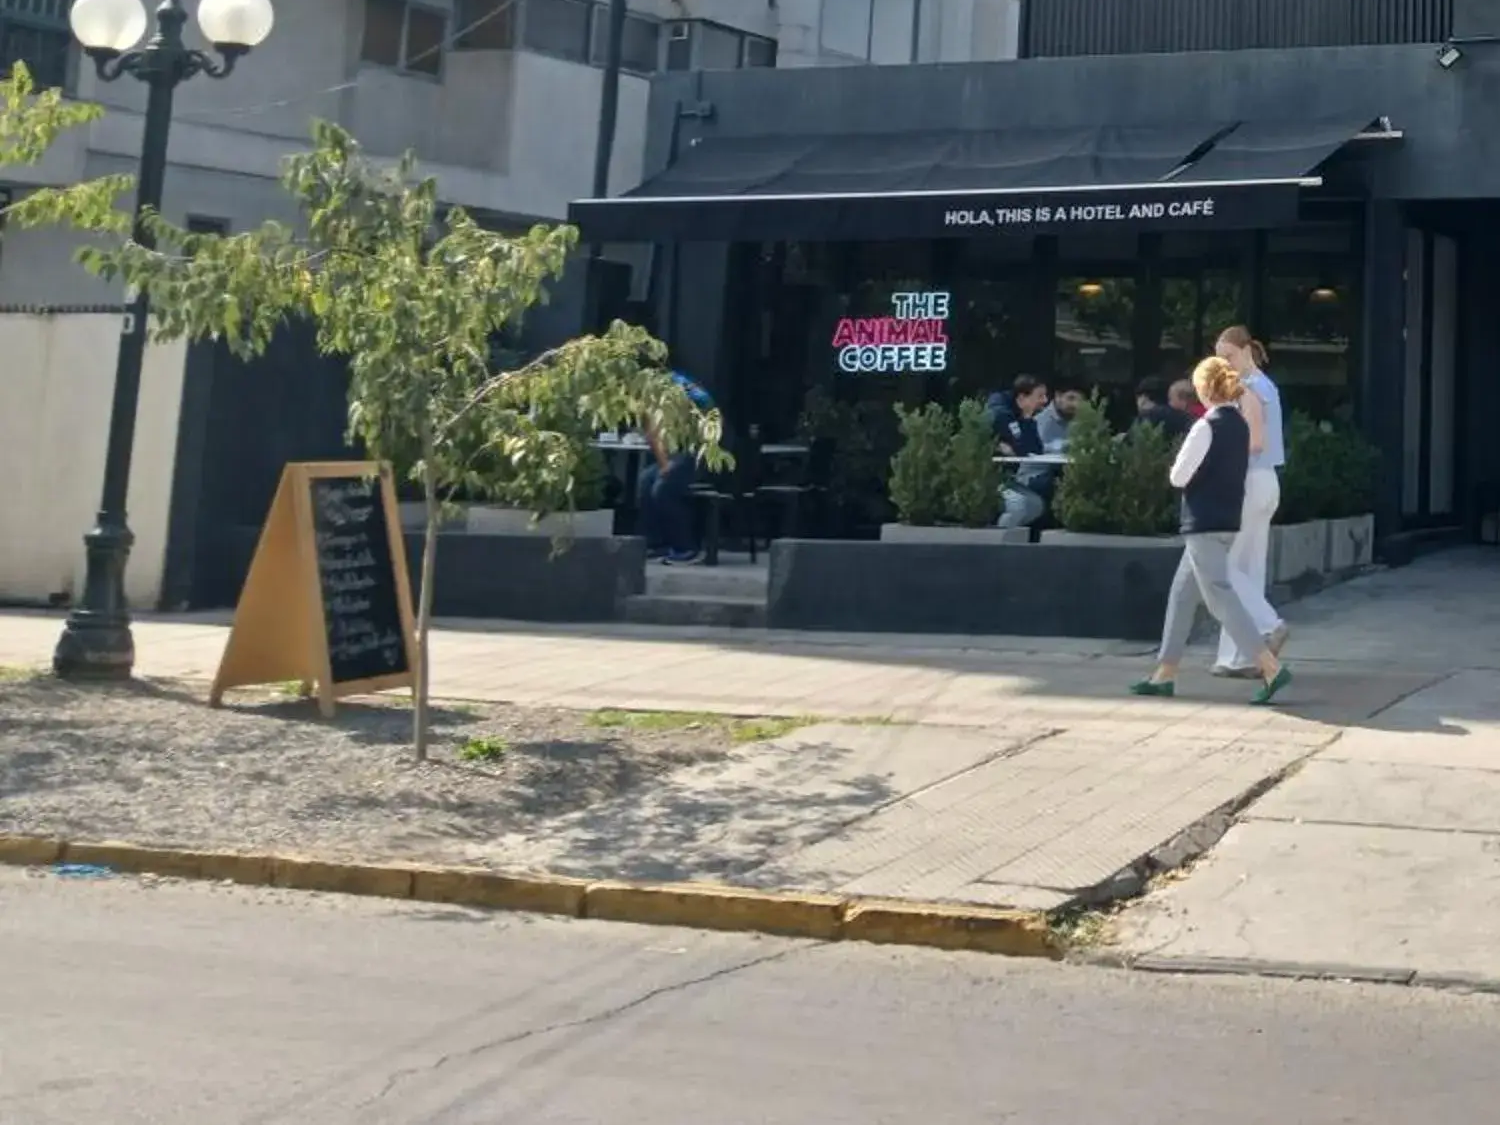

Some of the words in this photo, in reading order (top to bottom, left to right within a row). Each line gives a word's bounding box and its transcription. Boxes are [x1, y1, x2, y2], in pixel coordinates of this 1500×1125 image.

[945, 209, 994, 226] HOLA,
[996, 207, 1032, 224] THIS
[1036, 206, 1051, 223] IS
[1054, 205, 1067, 221] A
[1071, 203, 1125, 220] HOTEL
[1129, 202, 1165, 219] AND
[1168, 197, 1214, 217] CAFÉ
[891, 292, 949, 320] THE
[832, 317, 948, 347] ANIMAL
[839, 344, 947, 372] COFFEE
